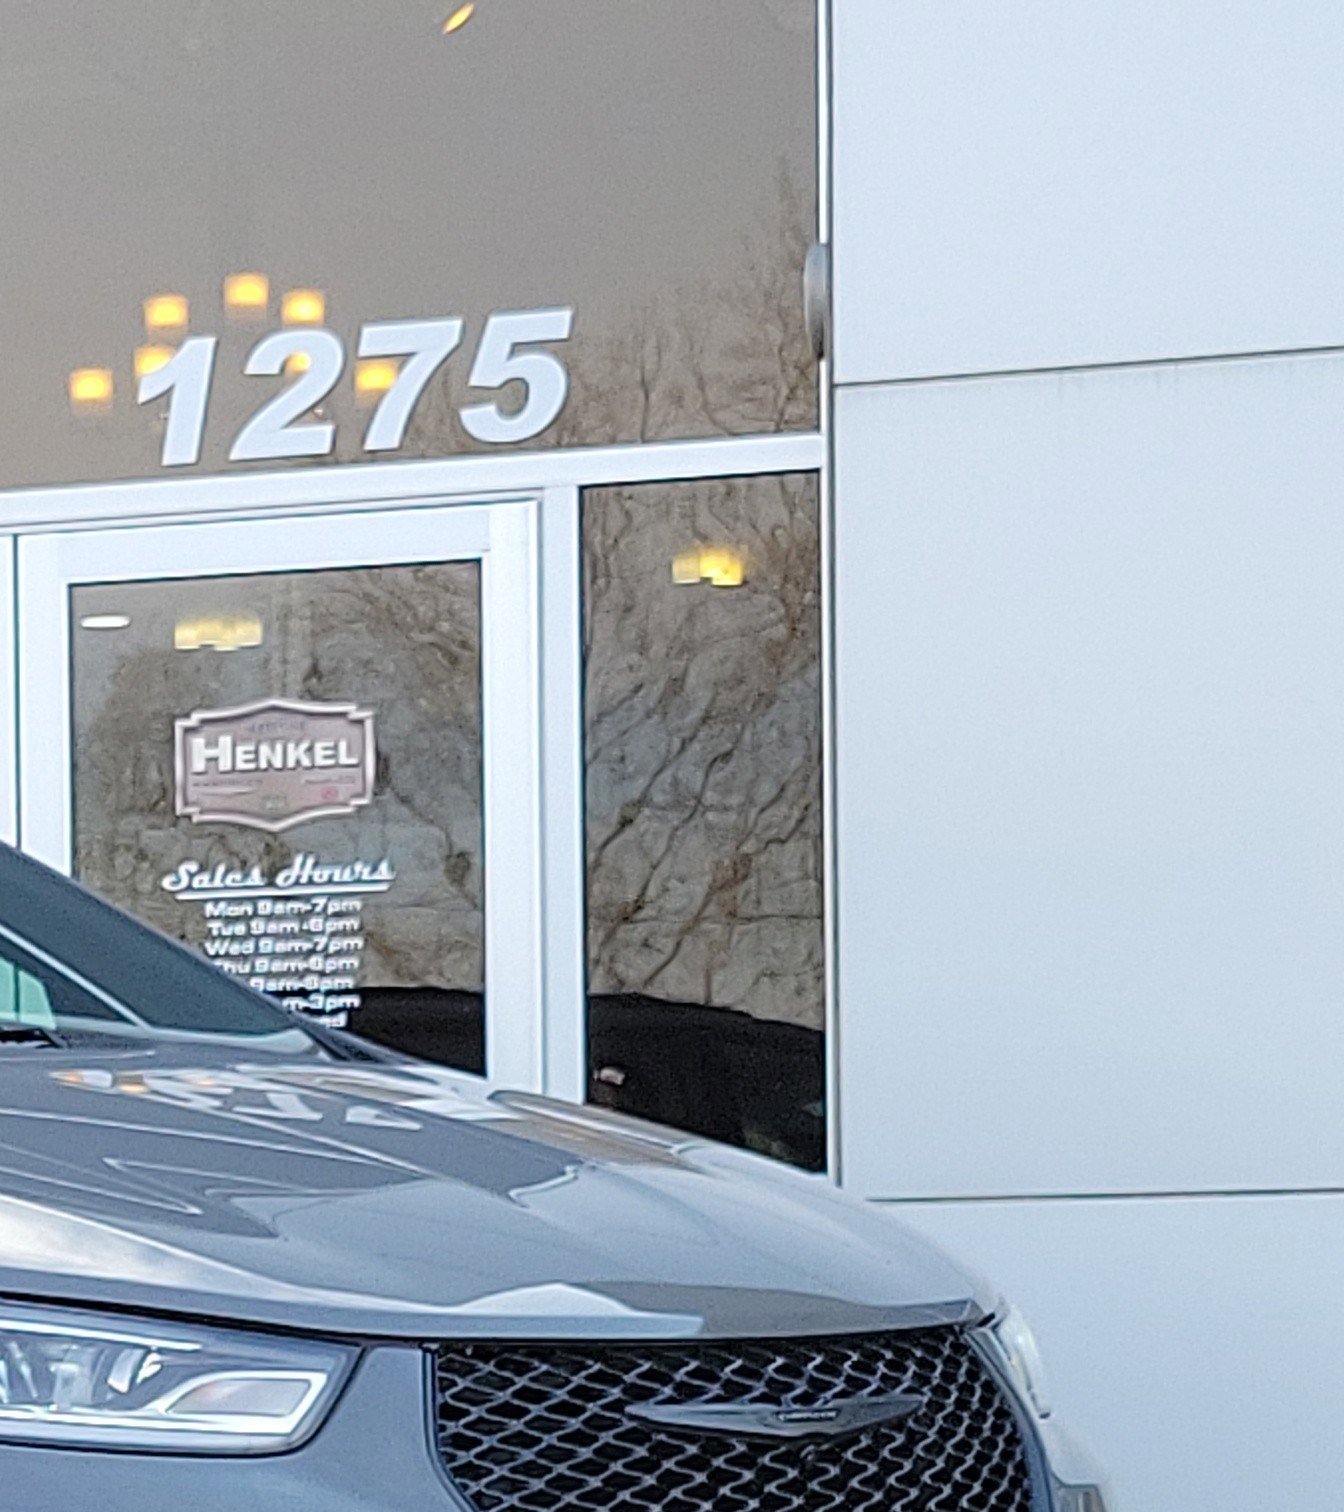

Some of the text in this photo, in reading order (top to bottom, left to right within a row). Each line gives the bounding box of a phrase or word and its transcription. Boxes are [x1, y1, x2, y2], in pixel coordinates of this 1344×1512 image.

[138, 305, 574, 467] 1275
[190, 735, 360, 773] HENKEL
[162, 853, 396, 892] Sales Hours
[205, 900, 254, 917] Mon
[207, 921, 246, 936] Tue
[204, 939, 255, 956] Wed
[282, 993, 361, 1012] m-3pm
